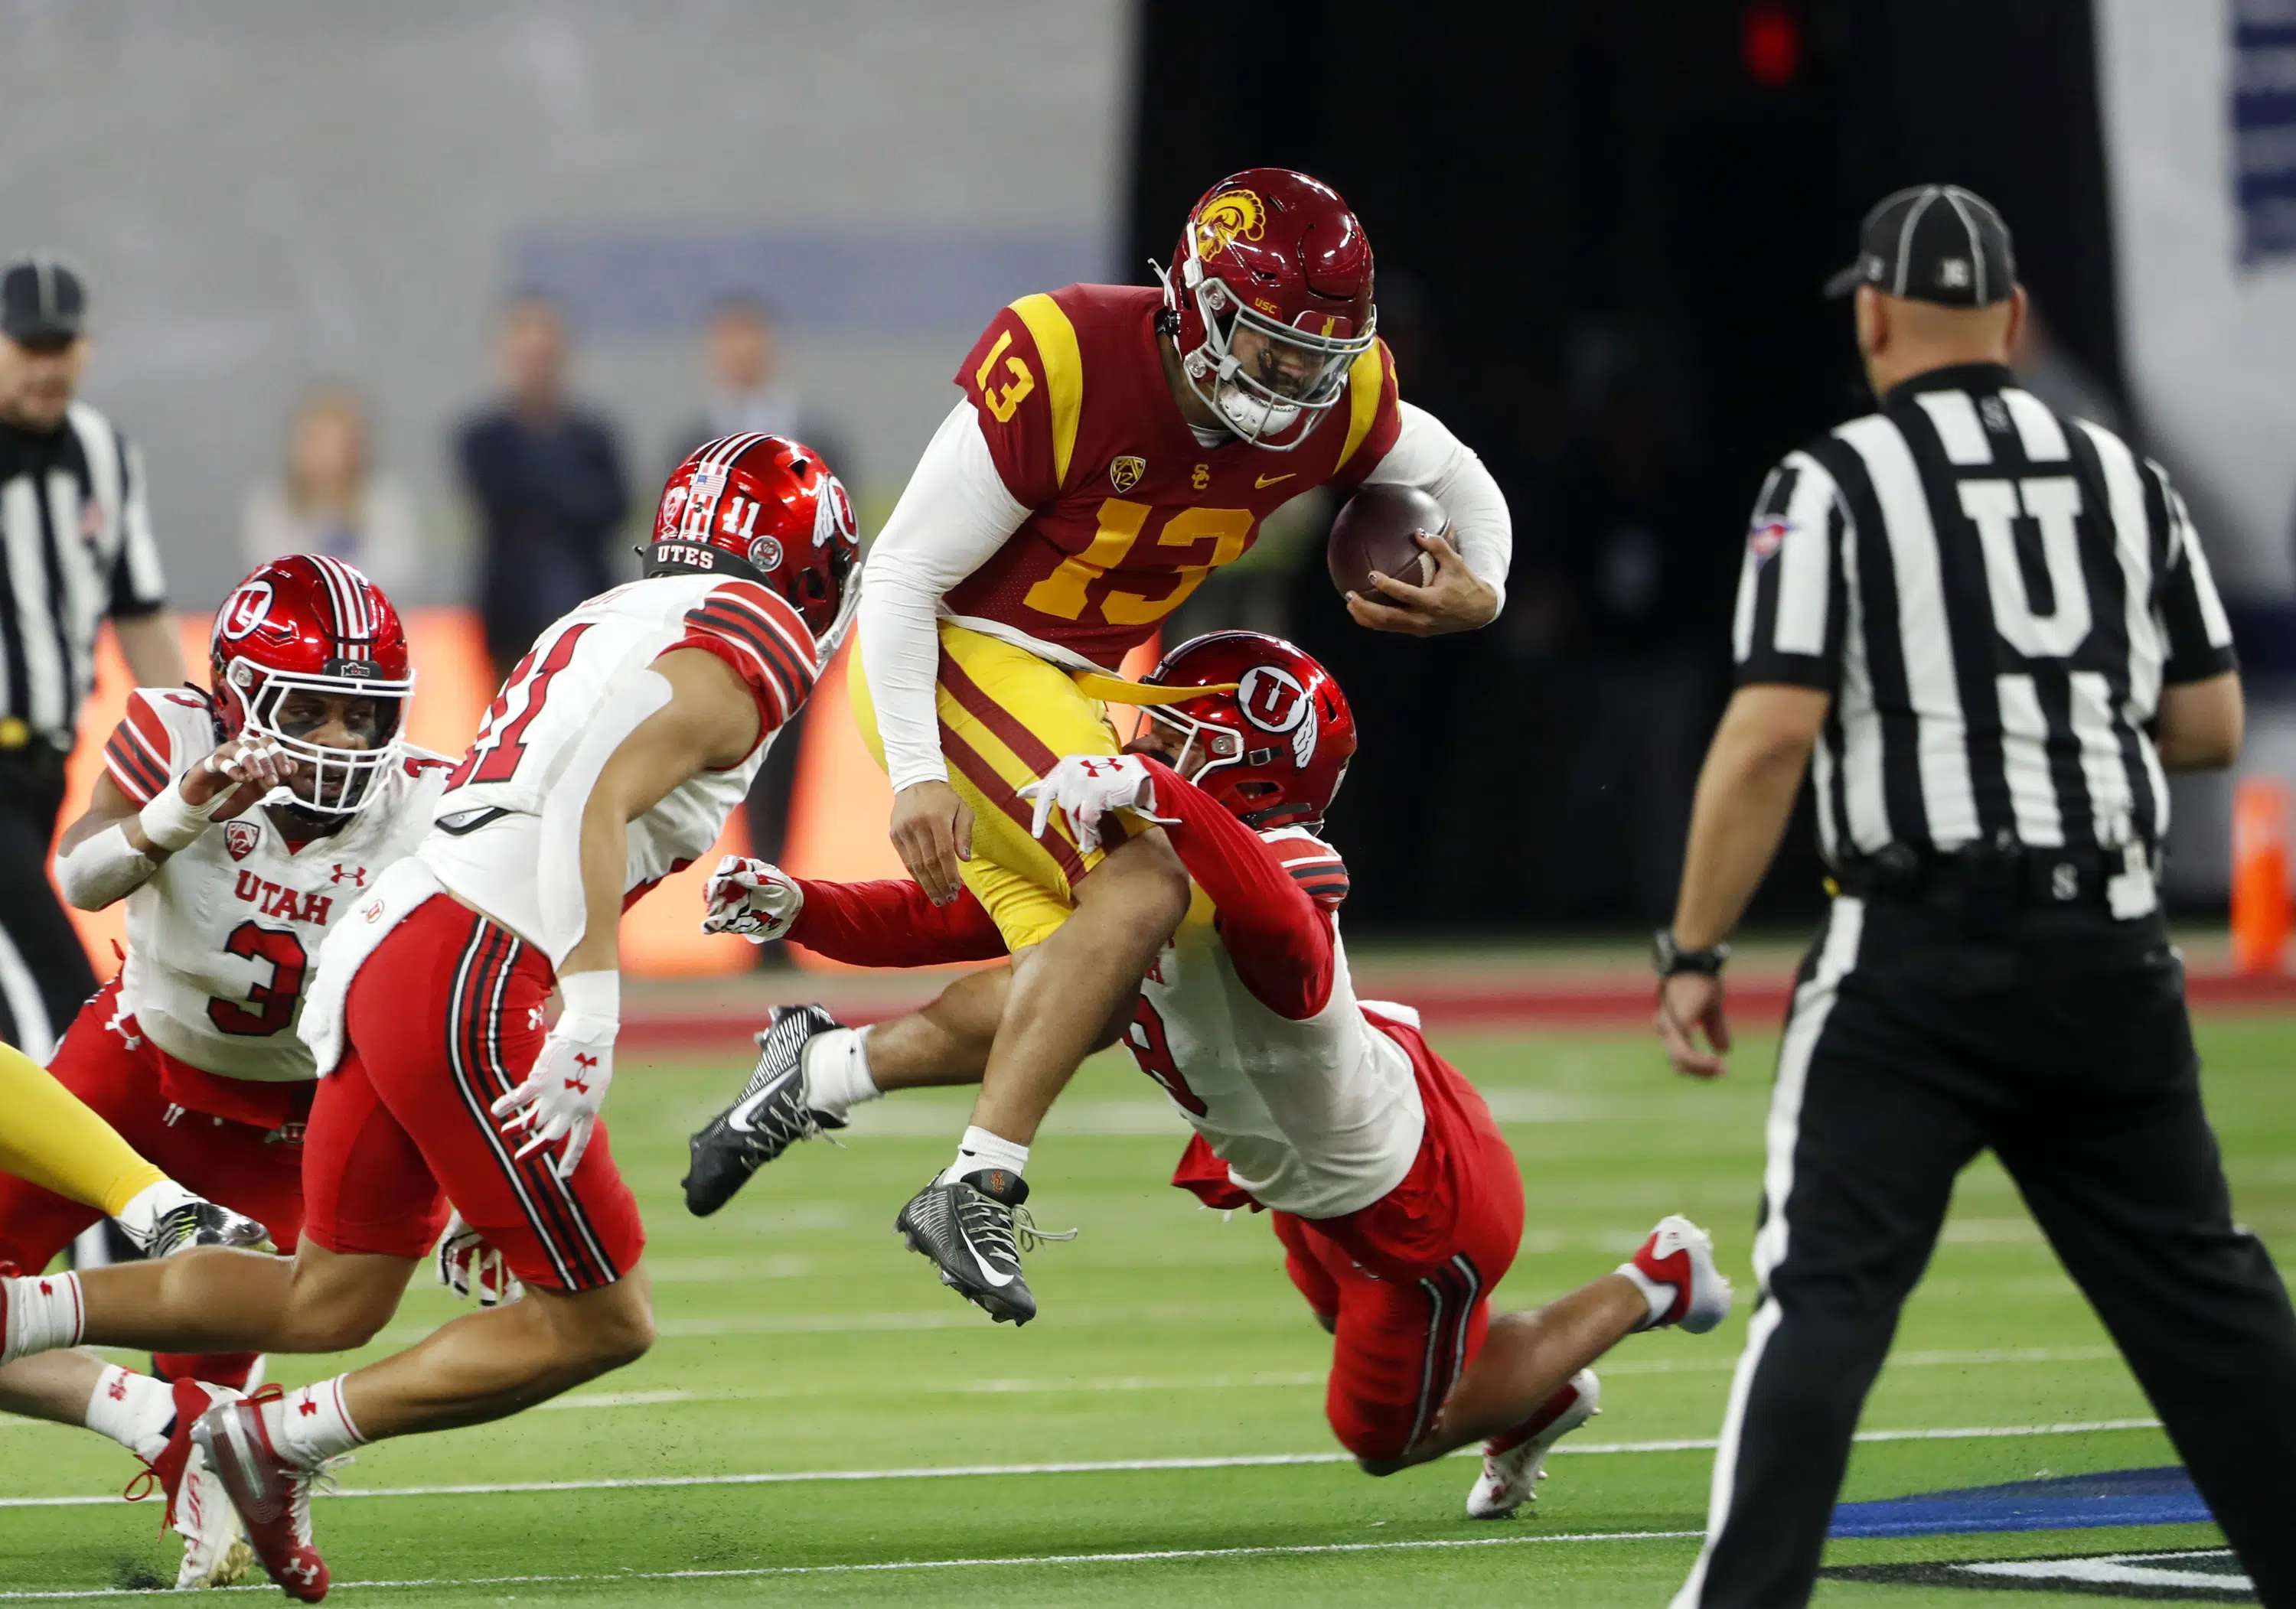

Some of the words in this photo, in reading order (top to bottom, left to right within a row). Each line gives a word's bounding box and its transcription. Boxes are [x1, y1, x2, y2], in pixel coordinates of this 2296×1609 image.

[1255, 298, 1277, 314] USC
[975, 329, 1035, 423] 13
[1113, 458, 1143, 480] PAC
[1115, 472, 1133, 486] 12
[1192, 464, 1210, 490] SC
[722, 496, 761, 540] 11
[657, 545, 714, 570] UTES
[1022, 497, 1255, 625] 13
[1957, 476, 2092, 658] U
[228, 590, 269, 632] U
[1248, 669, 1301, 728] U
[230, 839, 249, 854] 12
[234, 869, 333, 926] UTAH
[207, 920, 308, 1037] 3
